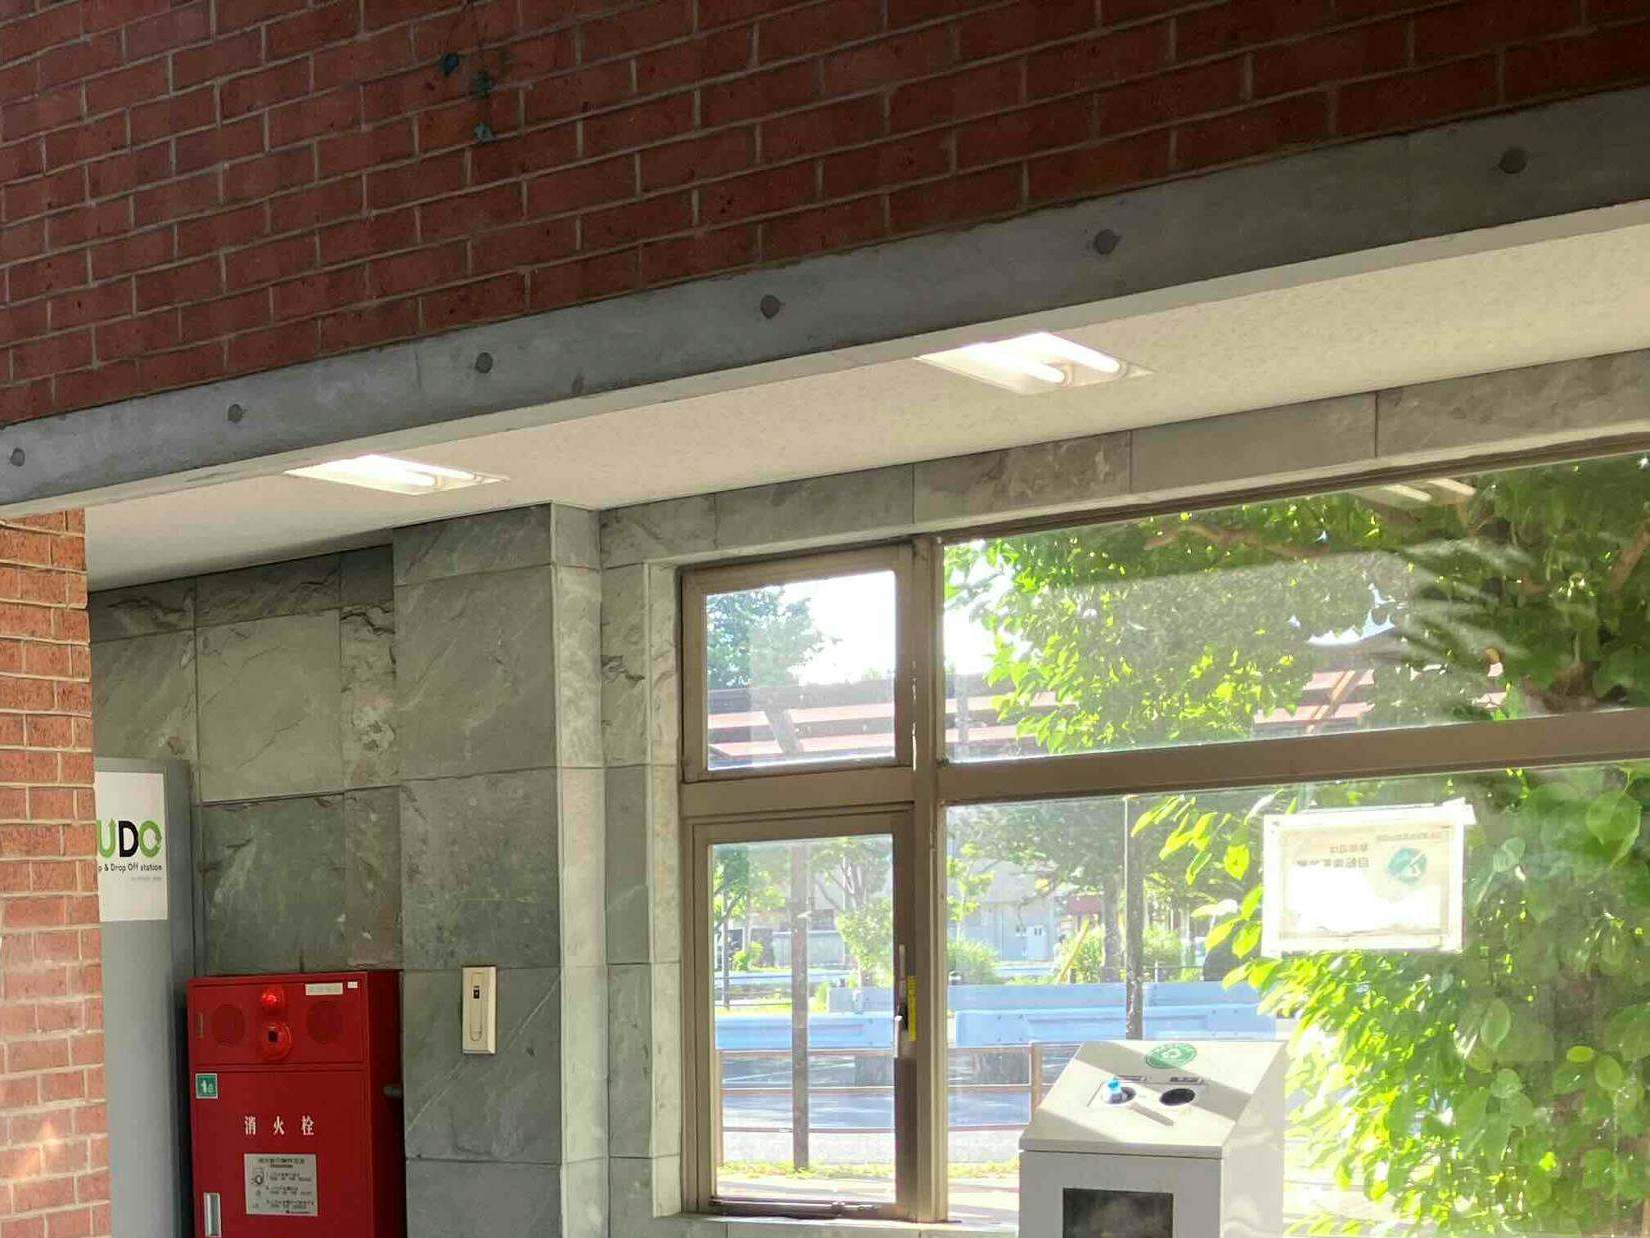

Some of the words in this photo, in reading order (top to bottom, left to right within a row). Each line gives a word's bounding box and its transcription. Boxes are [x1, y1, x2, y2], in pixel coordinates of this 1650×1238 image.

[111, 864, 126, 874] Drop
[128, 863, 139, 872] Off
[140, 863, 163, 872] station
[244, 1115, 315, 1136] 消火栓
